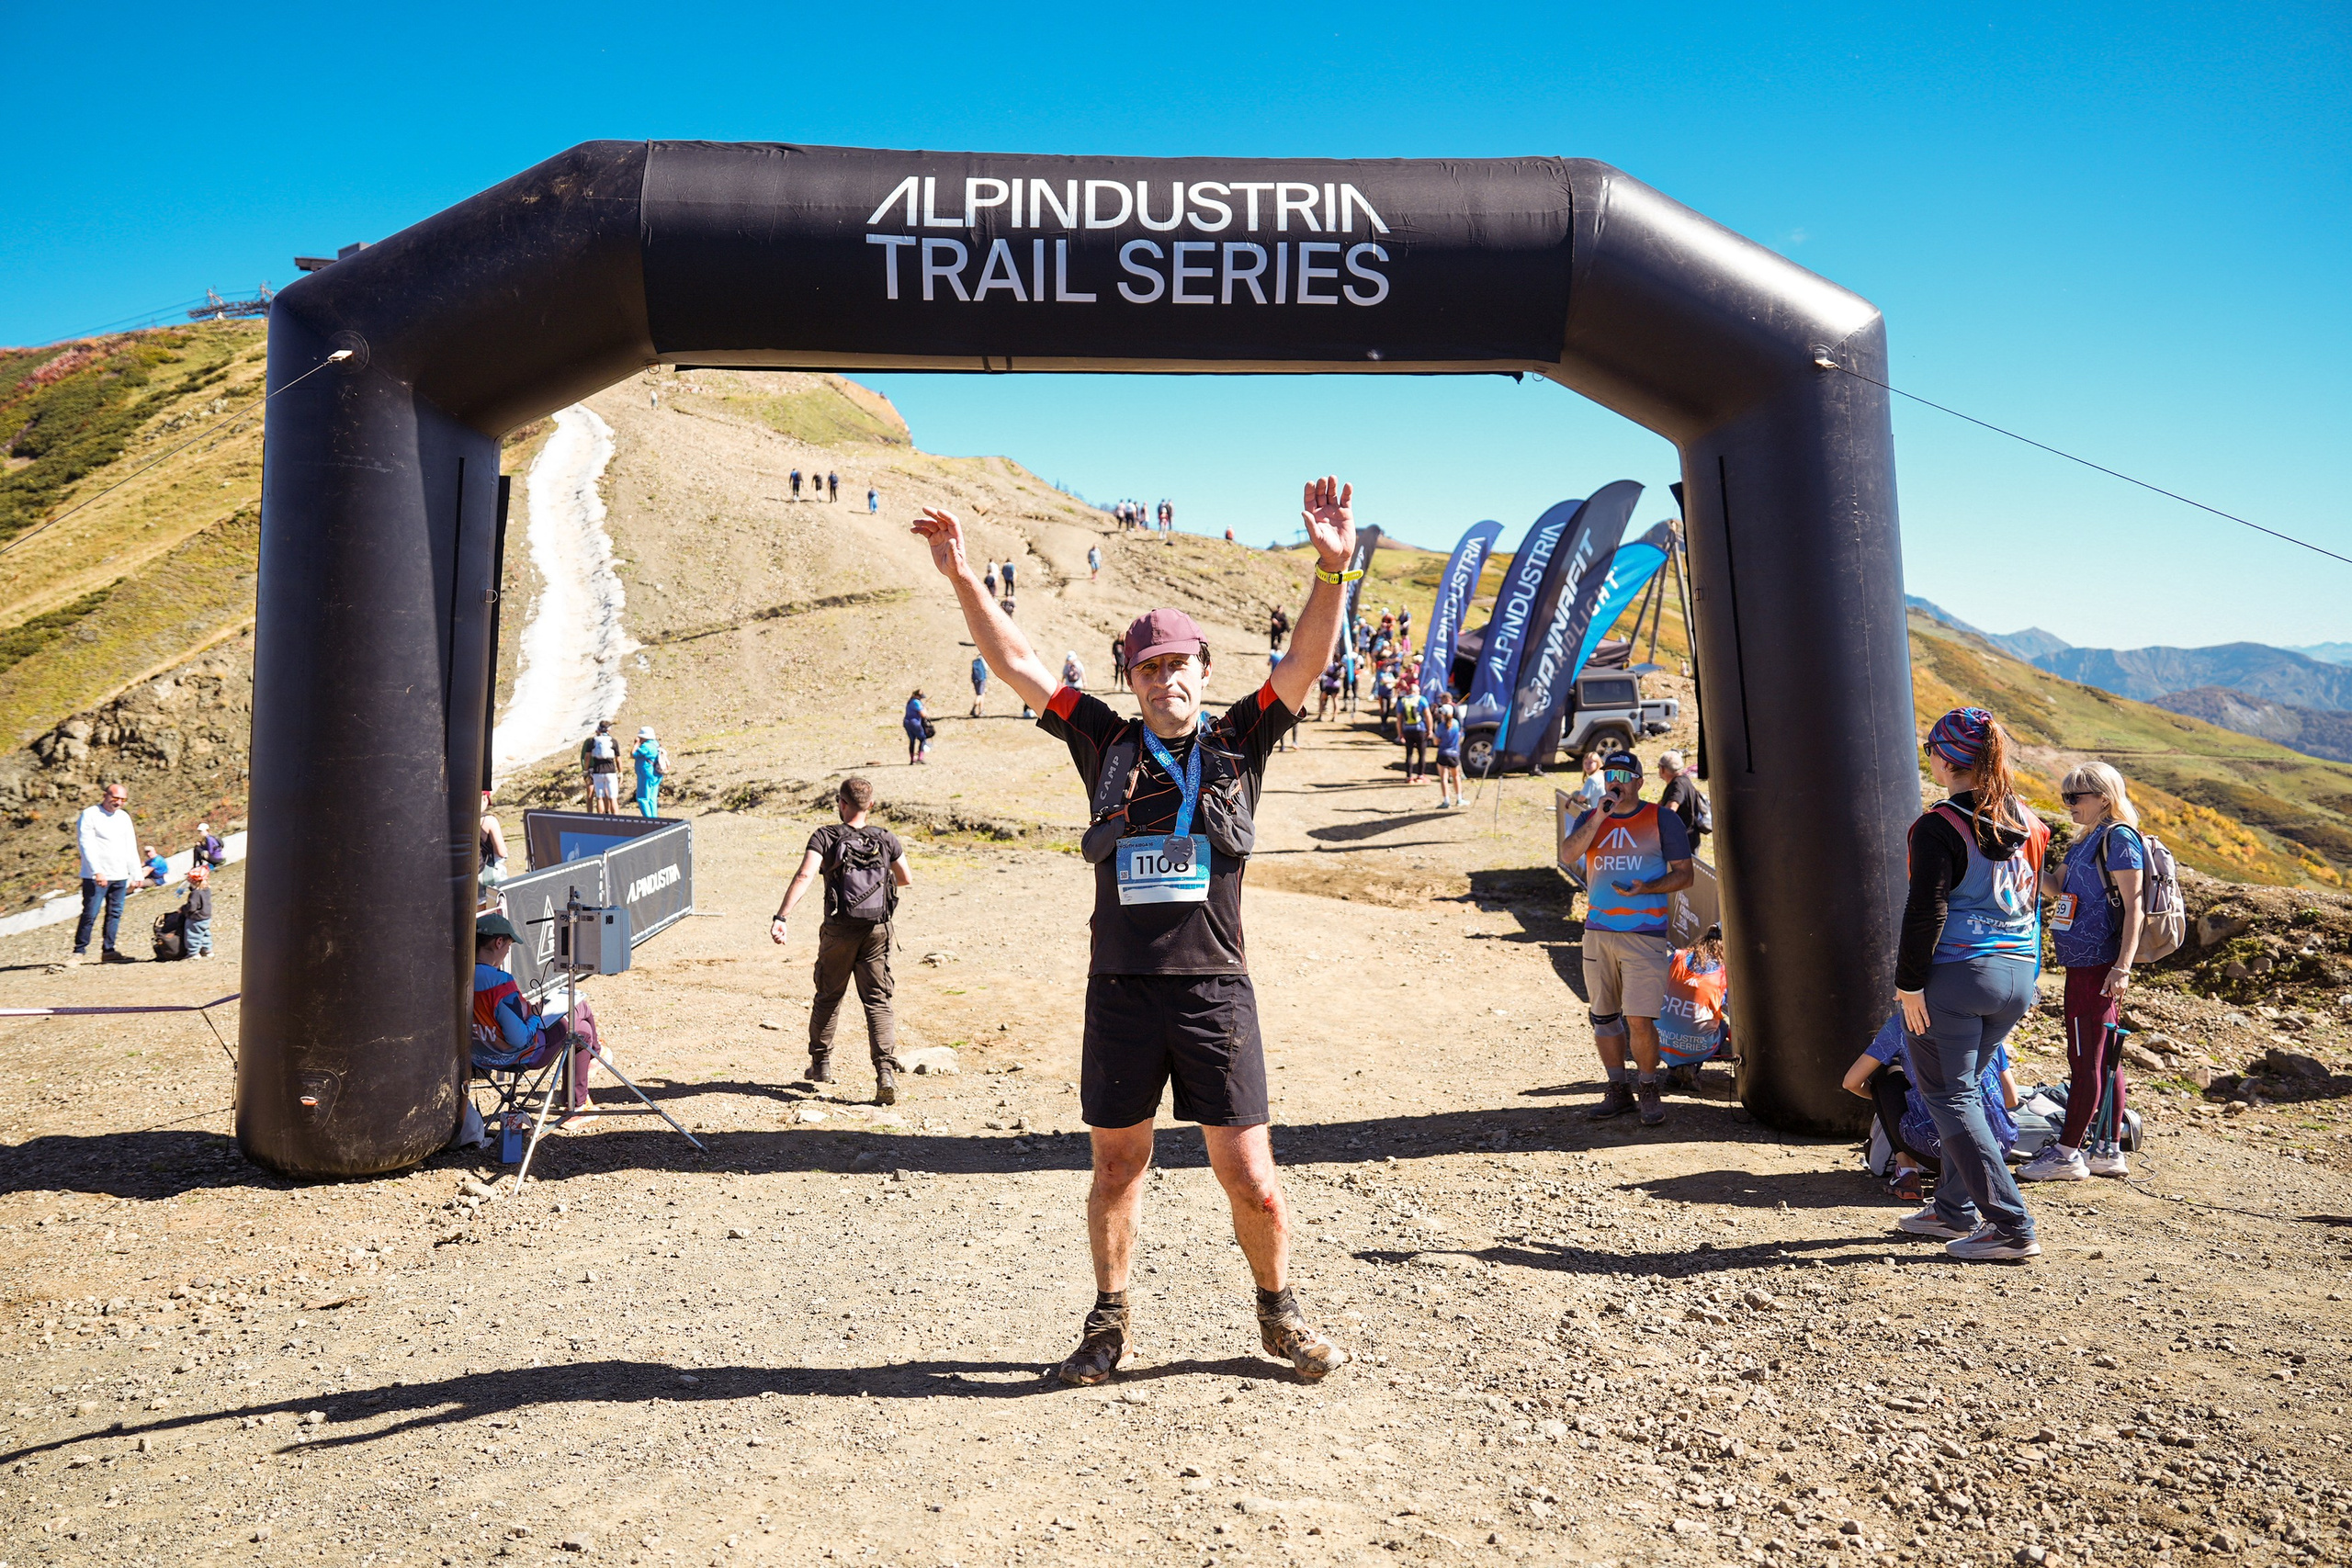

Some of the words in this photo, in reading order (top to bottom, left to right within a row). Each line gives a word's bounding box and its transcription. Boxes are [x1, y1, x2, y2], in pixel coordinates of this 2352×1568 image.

[865, 175, 1391, 234] ALPINDUSTRIA
[865, 233, 1097, 303] TRAIL
[1116, 239, 1390, 307] SERIES
[1433, 536, 1487, 669] ALPINDUSTRIA
[1488, 521, 1566, 683] ALPINDUSTRIA
[1537, 526, 1594, 689] DYNAFIT
[1099, 754, 1120, 802] CAMP
[1593, 855, 1643, 871] CREW
[1672, 1040, 1708, 1052] SERIES
